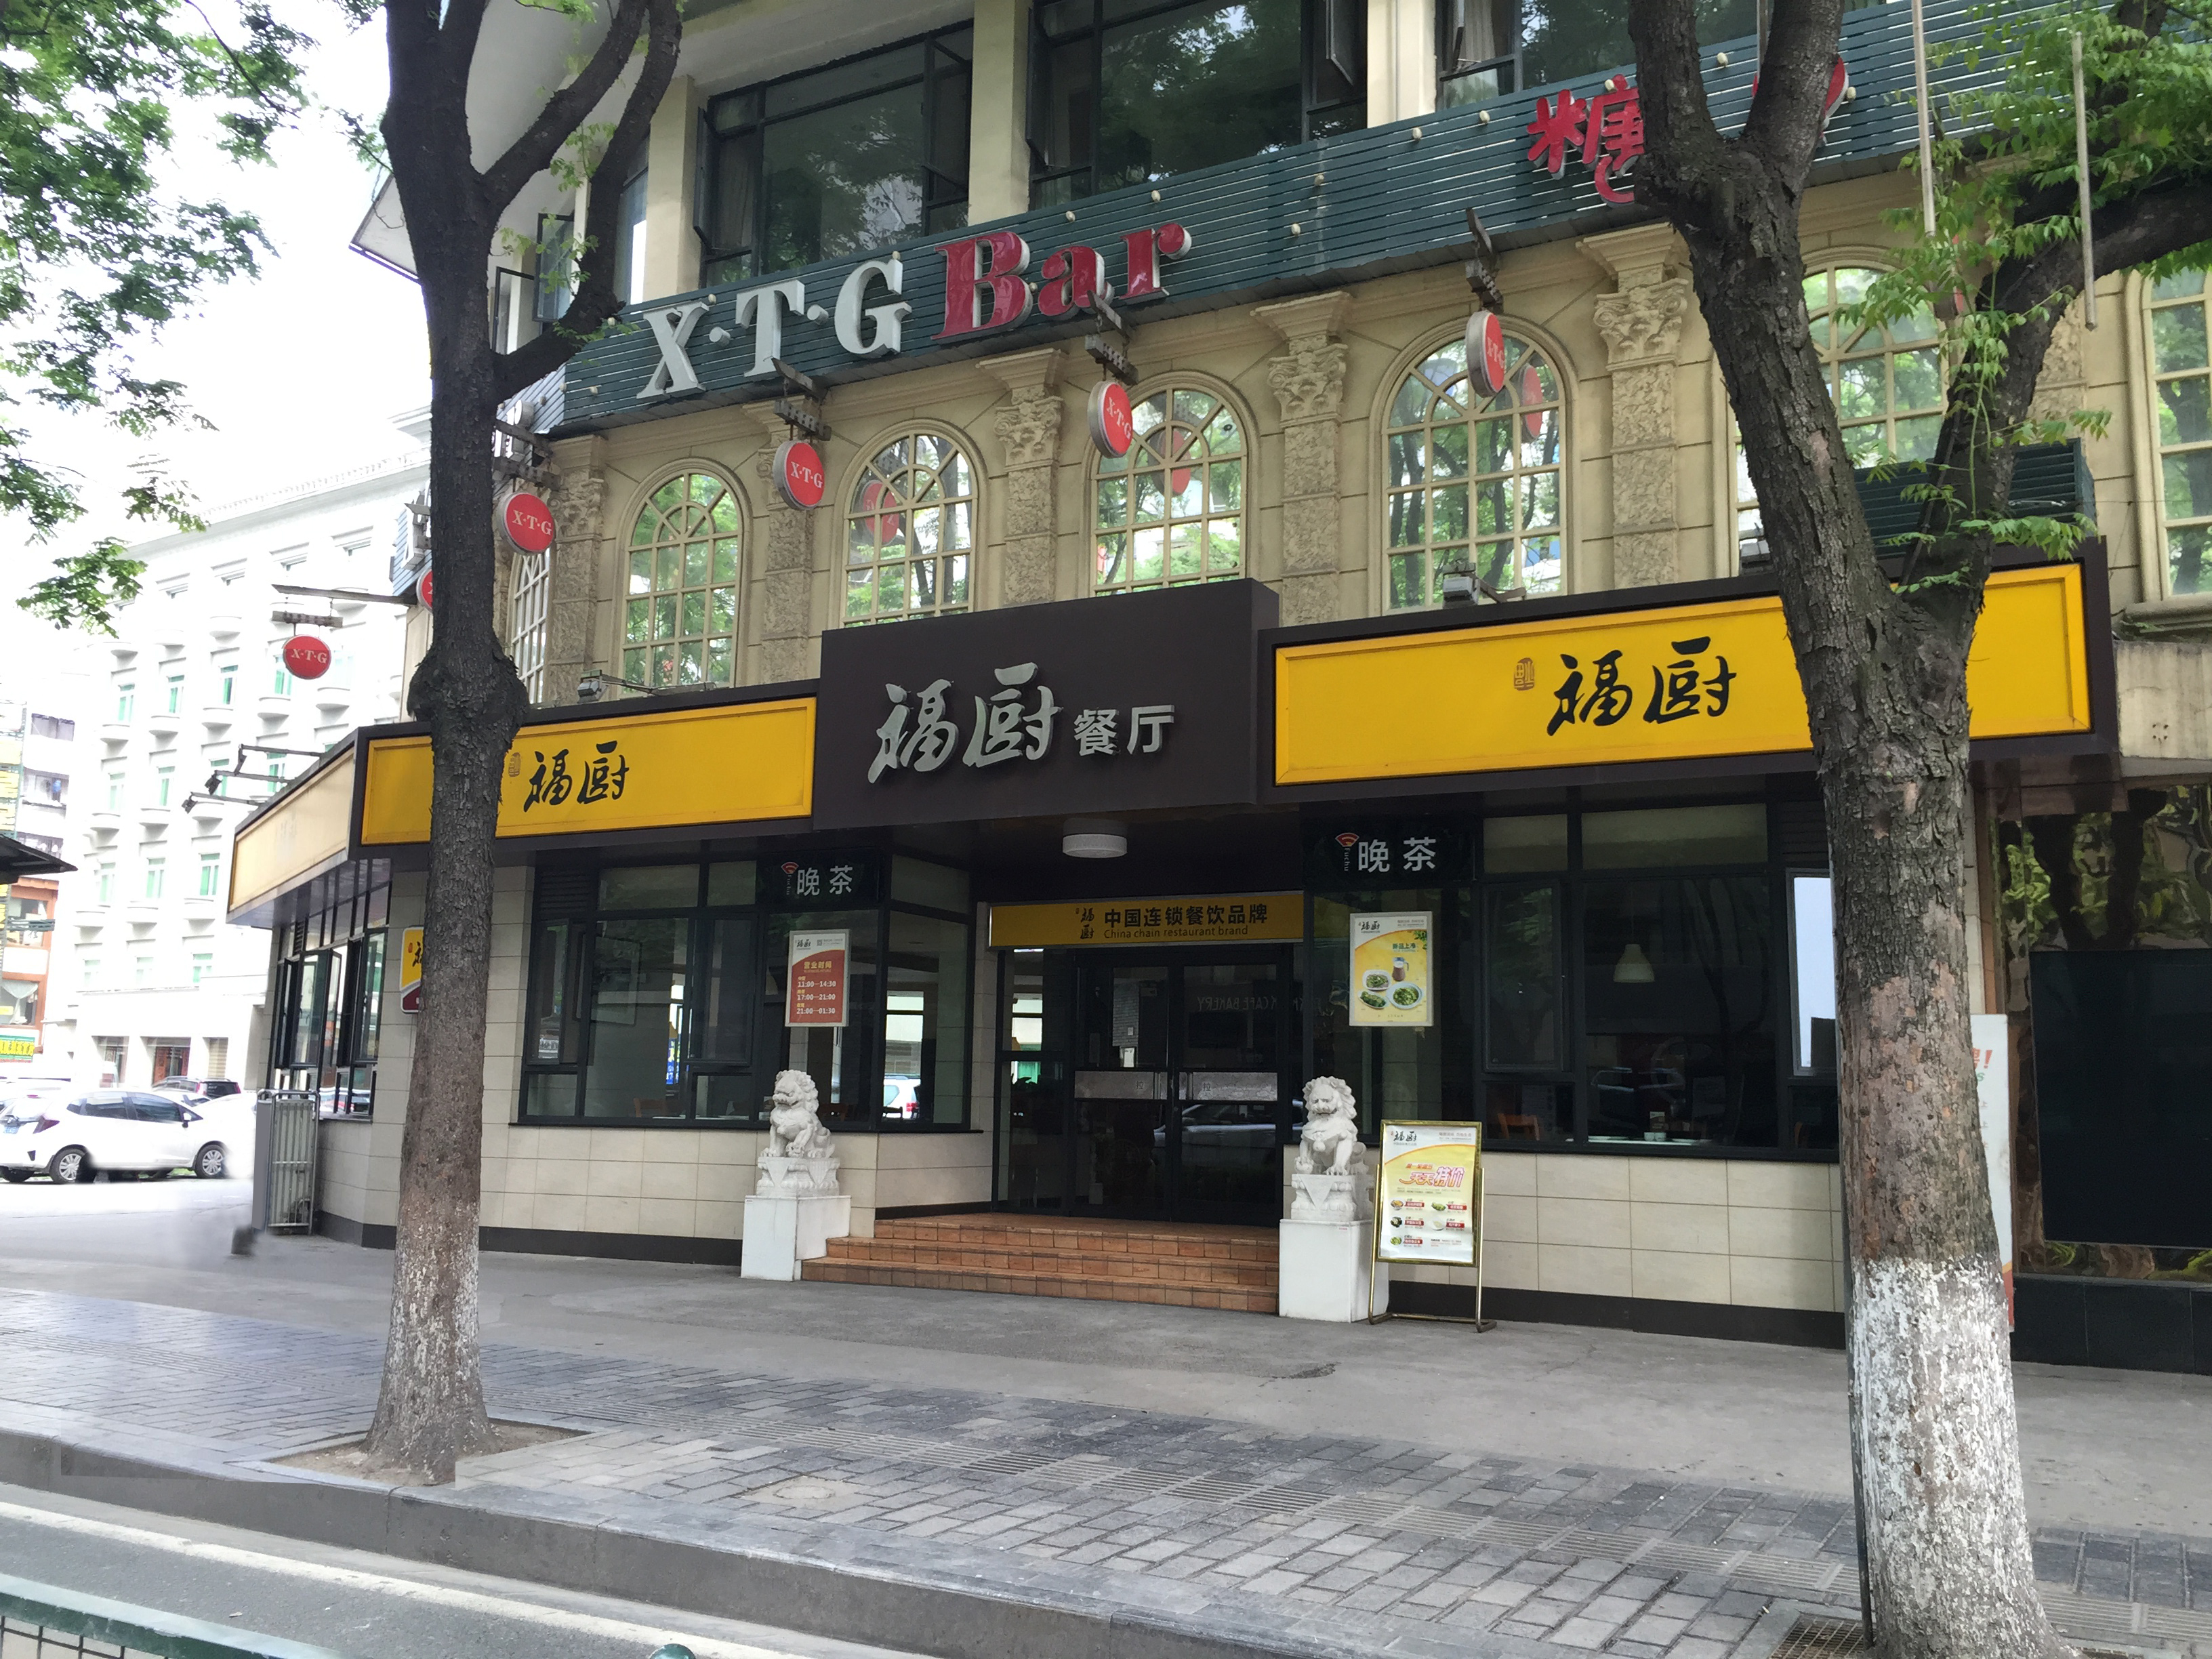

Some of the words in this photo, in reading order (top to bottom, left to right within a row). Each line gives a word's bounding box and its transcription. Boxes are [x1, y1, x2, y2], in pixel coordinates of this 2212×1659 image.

[930, 223, 1191, 341] Bar
[1547, 636, 1737, 736] 福厨
[867, 661, 1175, 783] 福厨餐厅
[523, 740, 630, 813] 福厨
[1357, 836, 1437, 873] 晚茶
[797, 865, 853, 896] 晚茶
[1103, 928, 1132, 939] China
[1134, 927, 1160, 938] chain
[1164, 927, 1216, 937] restaurant
[1218, 925, 1248, 936] brand
[1104, 903, 1268, 928] 中国连锁餐饮品牌
[1399, 1166, 1465, 1187] 天天特价
